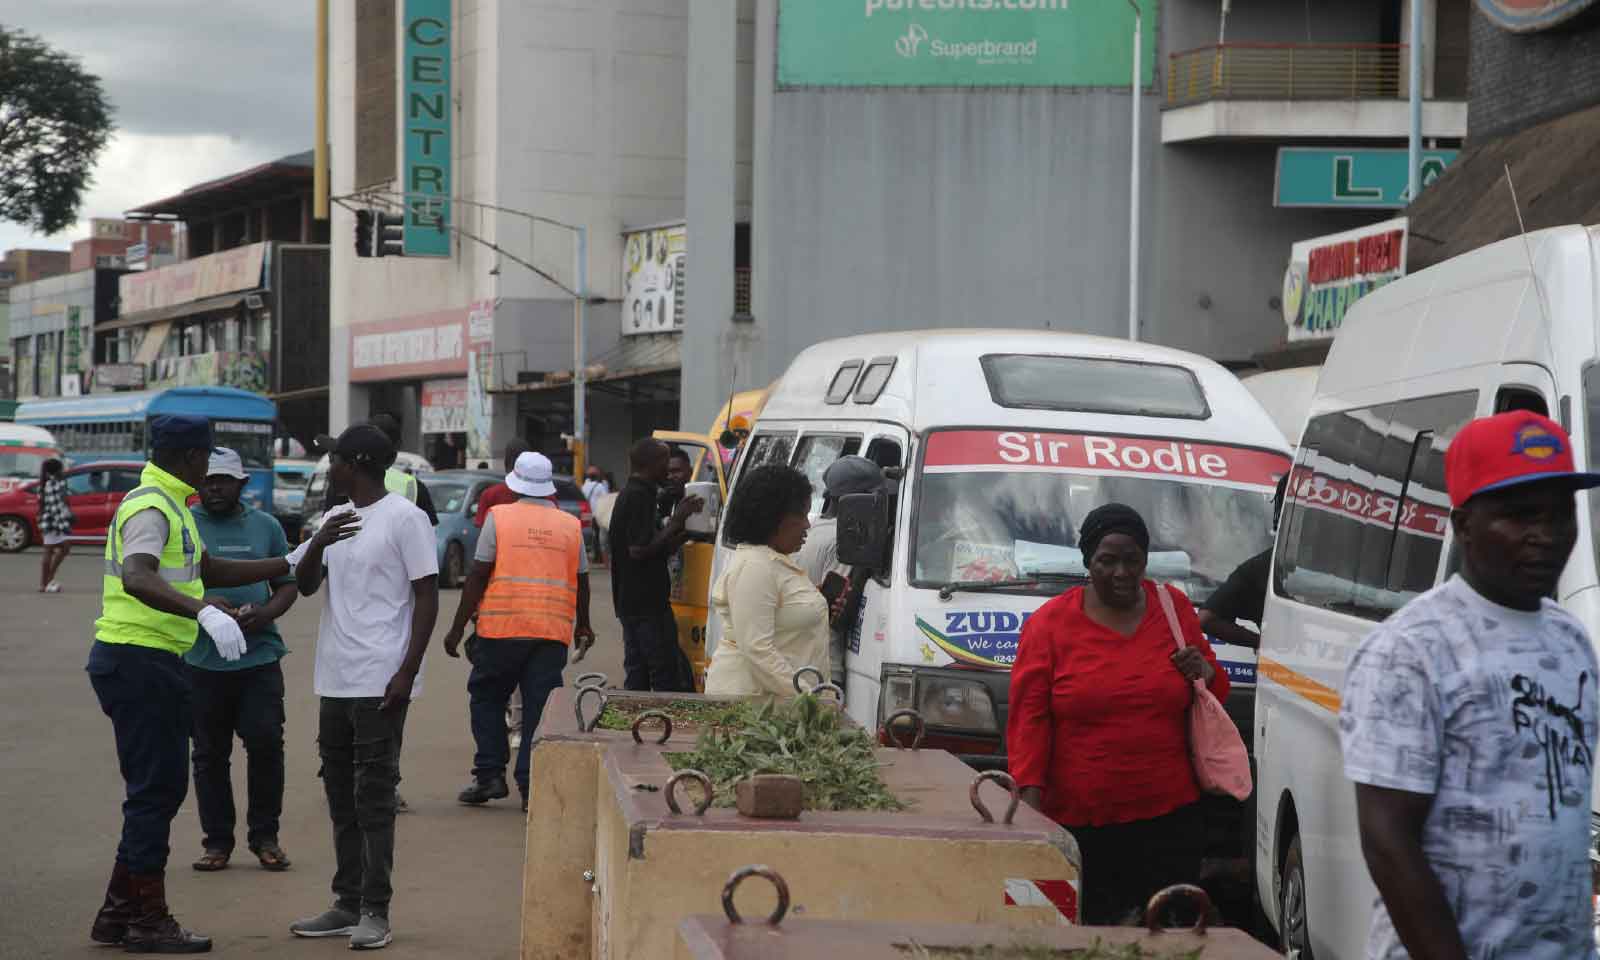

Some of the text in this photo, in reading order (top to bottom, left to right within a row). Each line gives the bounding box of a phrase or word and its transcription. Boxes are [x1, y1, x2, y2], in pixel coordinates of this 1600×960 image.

[929, 38, 1037, 58] Superbrand
[407, 17, 445, 229] CENTRE
[997, 431, 1229, 478] Sir Rodie
[968, 639, 993, 650] We
